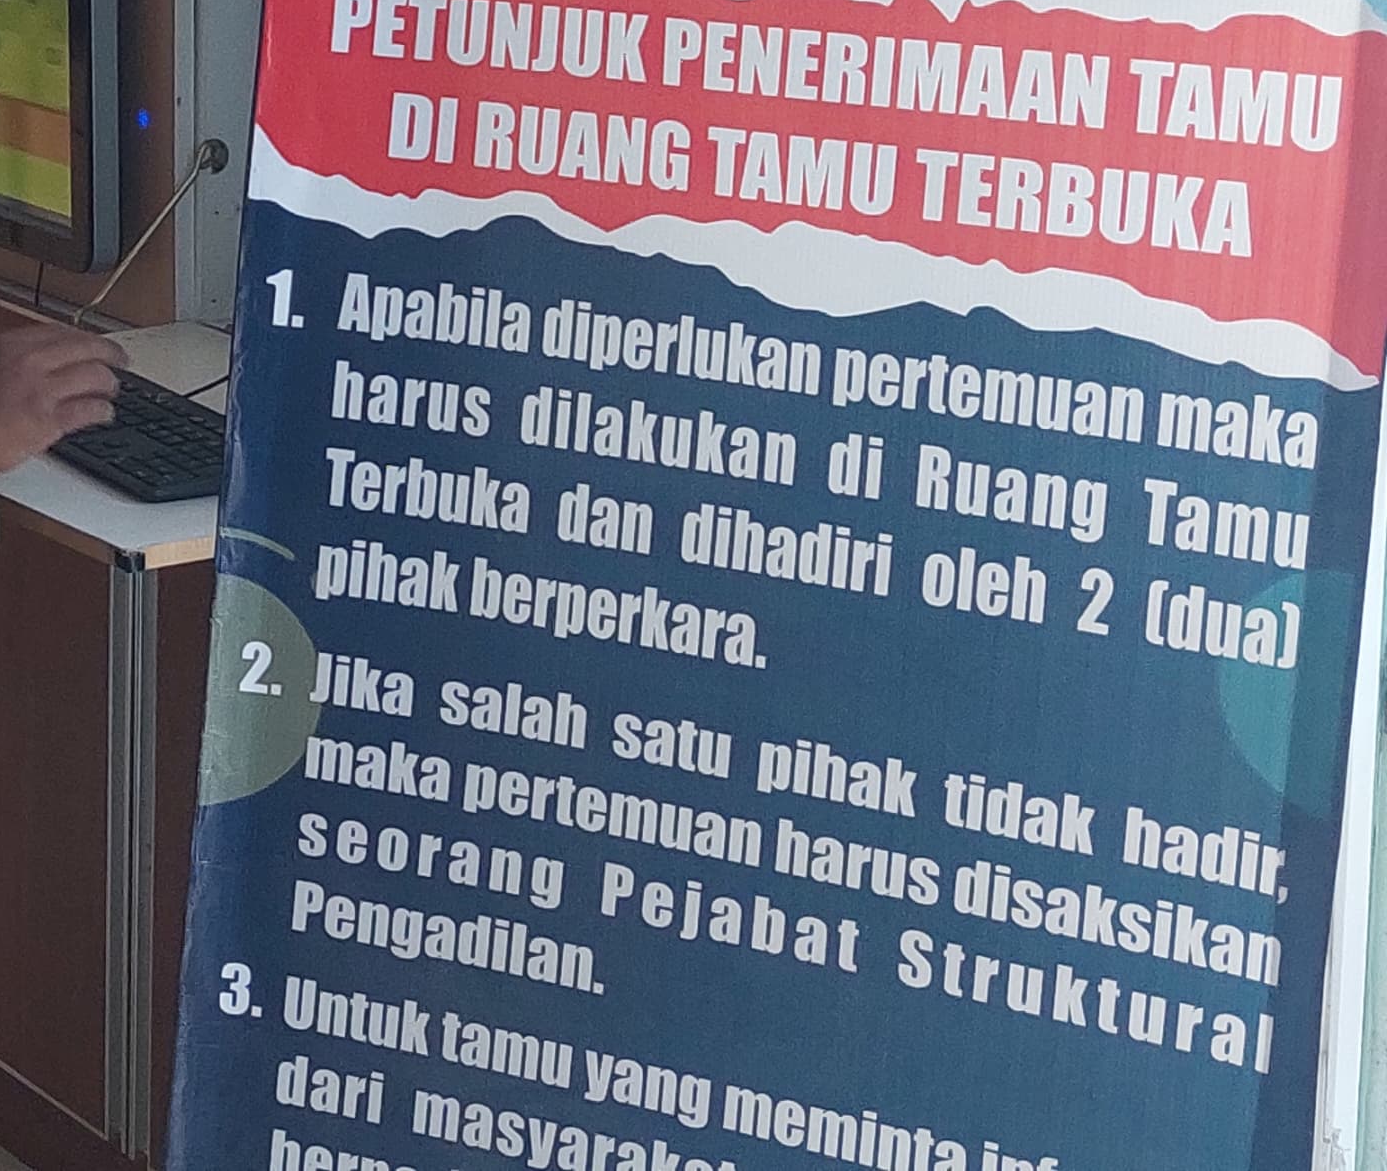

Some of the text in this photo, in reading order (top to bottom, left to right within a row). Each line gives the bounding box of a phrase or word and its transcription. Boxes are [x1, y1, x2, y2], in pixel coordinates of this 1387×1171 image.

[387, 91, 1254, 258] DI RUANG TAMU TERBUKA
[662, 20, 1112, 130] PENERIMAAN
[1129, 59, 1343, 152] TAMU
[264, 268, 1319, 469] 1. Apabila diperlukan pertemuan maka
[331, 360, 1311, 570] harus dilakukan di Ruang Tamu
[315, 539, 767, 669] pihak berperkara.
[325, 447, 1302, 669] Terbuka dan dihadiri oleh 2 (dua)
[238, 640, 1290, 905] 2. Jika salah satu pihak tidak hadir,
[304, 734, 1282, 988] maka pertemuan harus disaksikan
[291, 879, 605, 996] Pengadilan.
[298, 811, 1275, 1075] seorang Pejabat Struktural
[218, 962, 968, 1171] 3. Untuk tamu yang meminta
[275, 1055, 386, 1125] dari
[412, 1088, 738, 1171] masyarak
